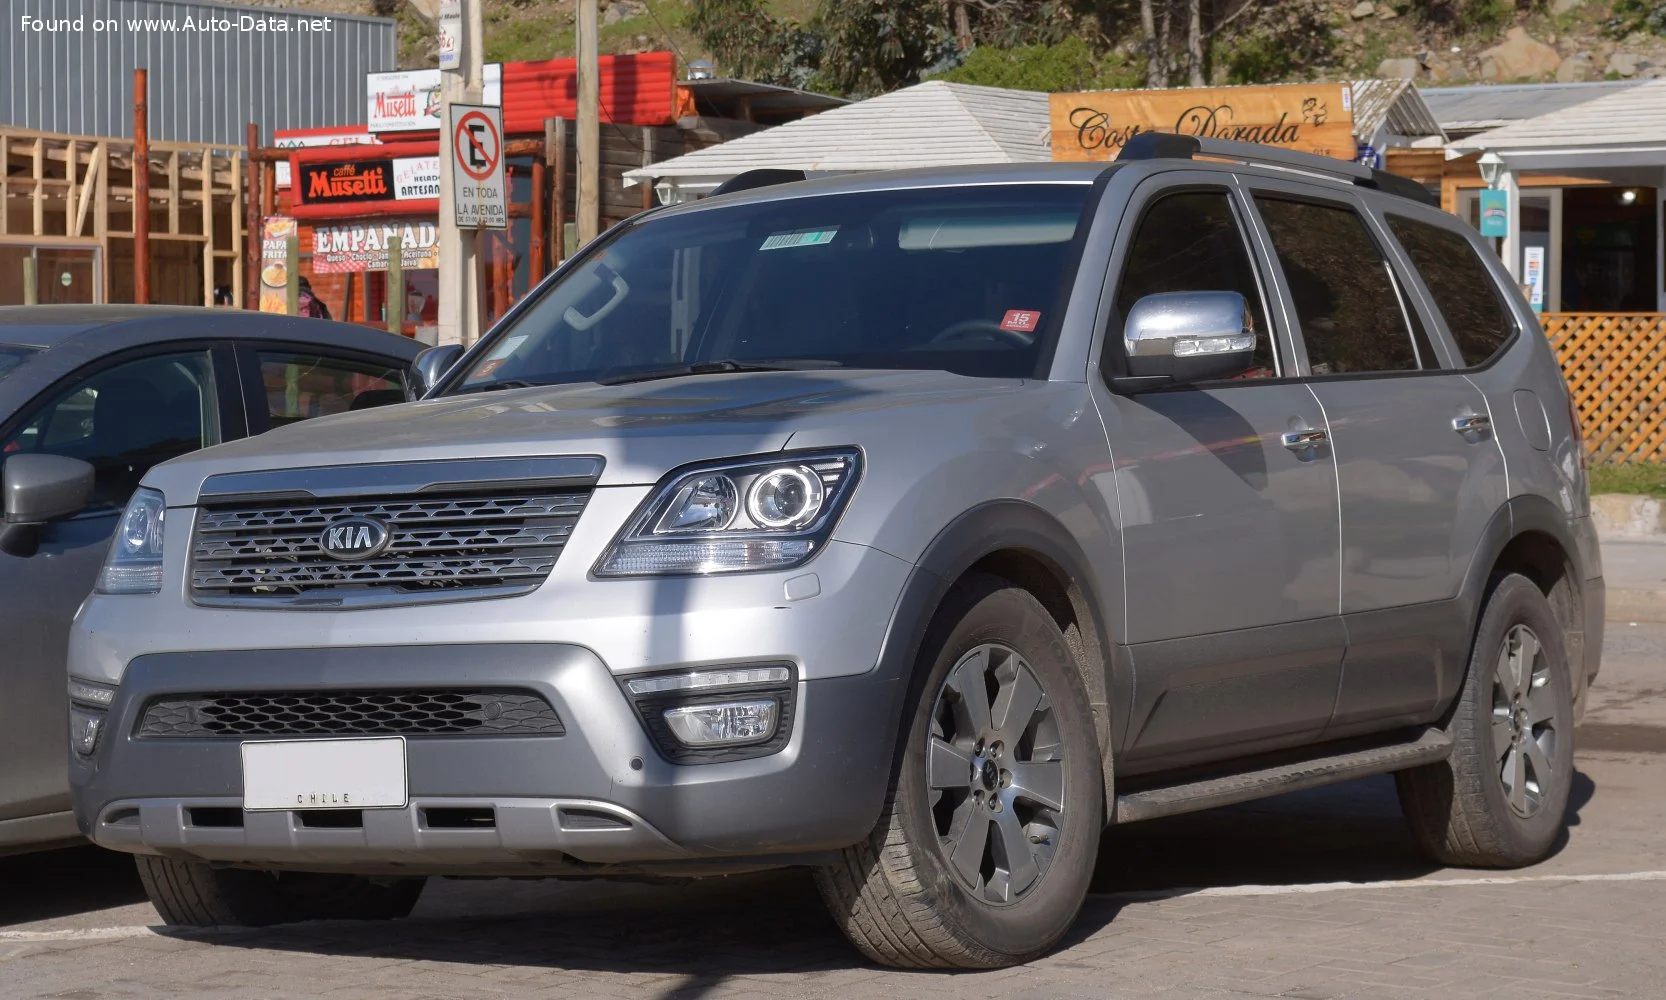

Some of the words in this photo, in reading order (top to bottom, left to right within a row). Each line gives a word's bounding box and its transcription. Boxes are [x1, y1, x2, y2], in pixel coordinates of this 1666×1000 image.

[374, 83, 417, 119] Musetti
[1069, 107, 1155, 150] Cost
[308, 166, 387, 198] Musetti
[462, 187, 475, 198] EN
[476, 187, 498, 199] TODA
[457, 203, 469, 215] LA
[471, 204, 504, 216] AVENIDA
[316, 222, 440, 253] EMPANAD
[328, 526, 372, 550] KIA
[297, 793, 350, 804] CHILE
